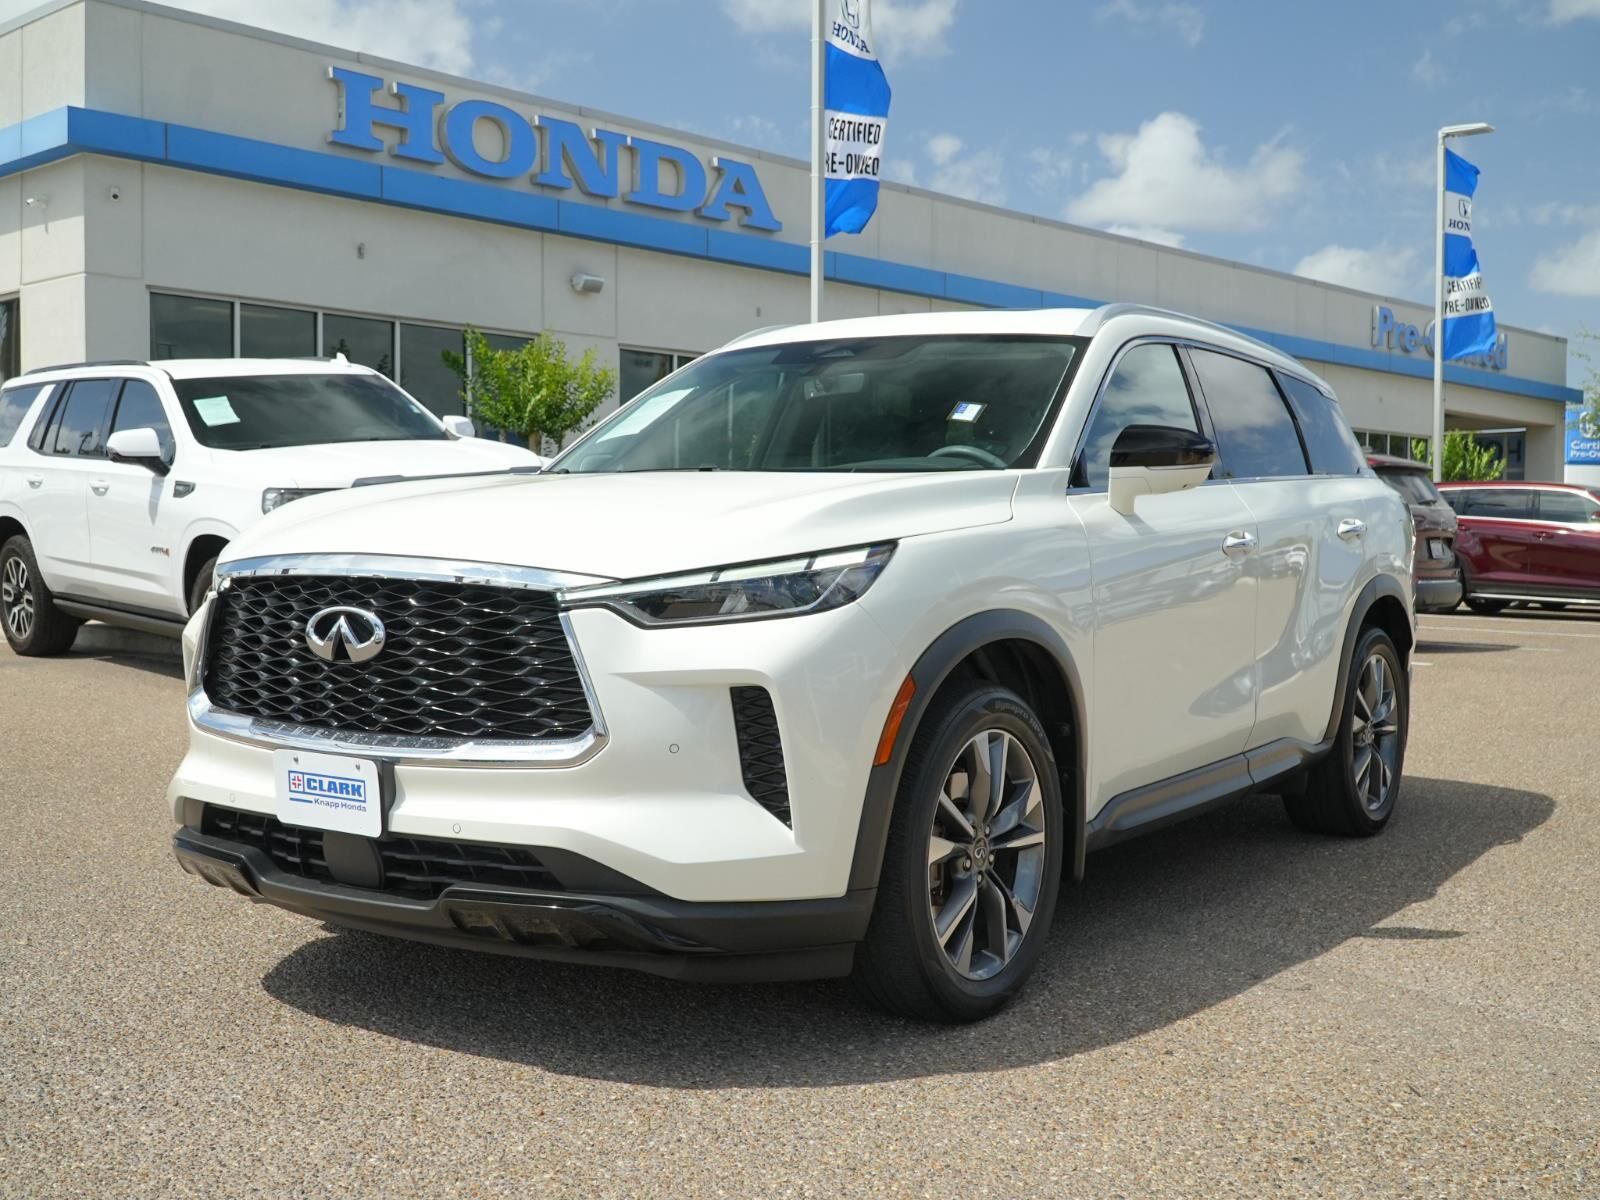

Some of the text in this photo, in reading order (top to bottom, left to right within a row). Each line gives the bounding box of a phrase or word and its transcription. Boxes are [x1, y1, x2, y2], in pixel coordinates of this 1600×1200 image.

[829, 117, 881, 145] CERTIFIED
[327, 66, 782, 232] HONDA
[1448, 218, 1471, 231] HON
[306, 777, 363, 797] CLARK
[314, 798, 367, 812] Knapp Honda
